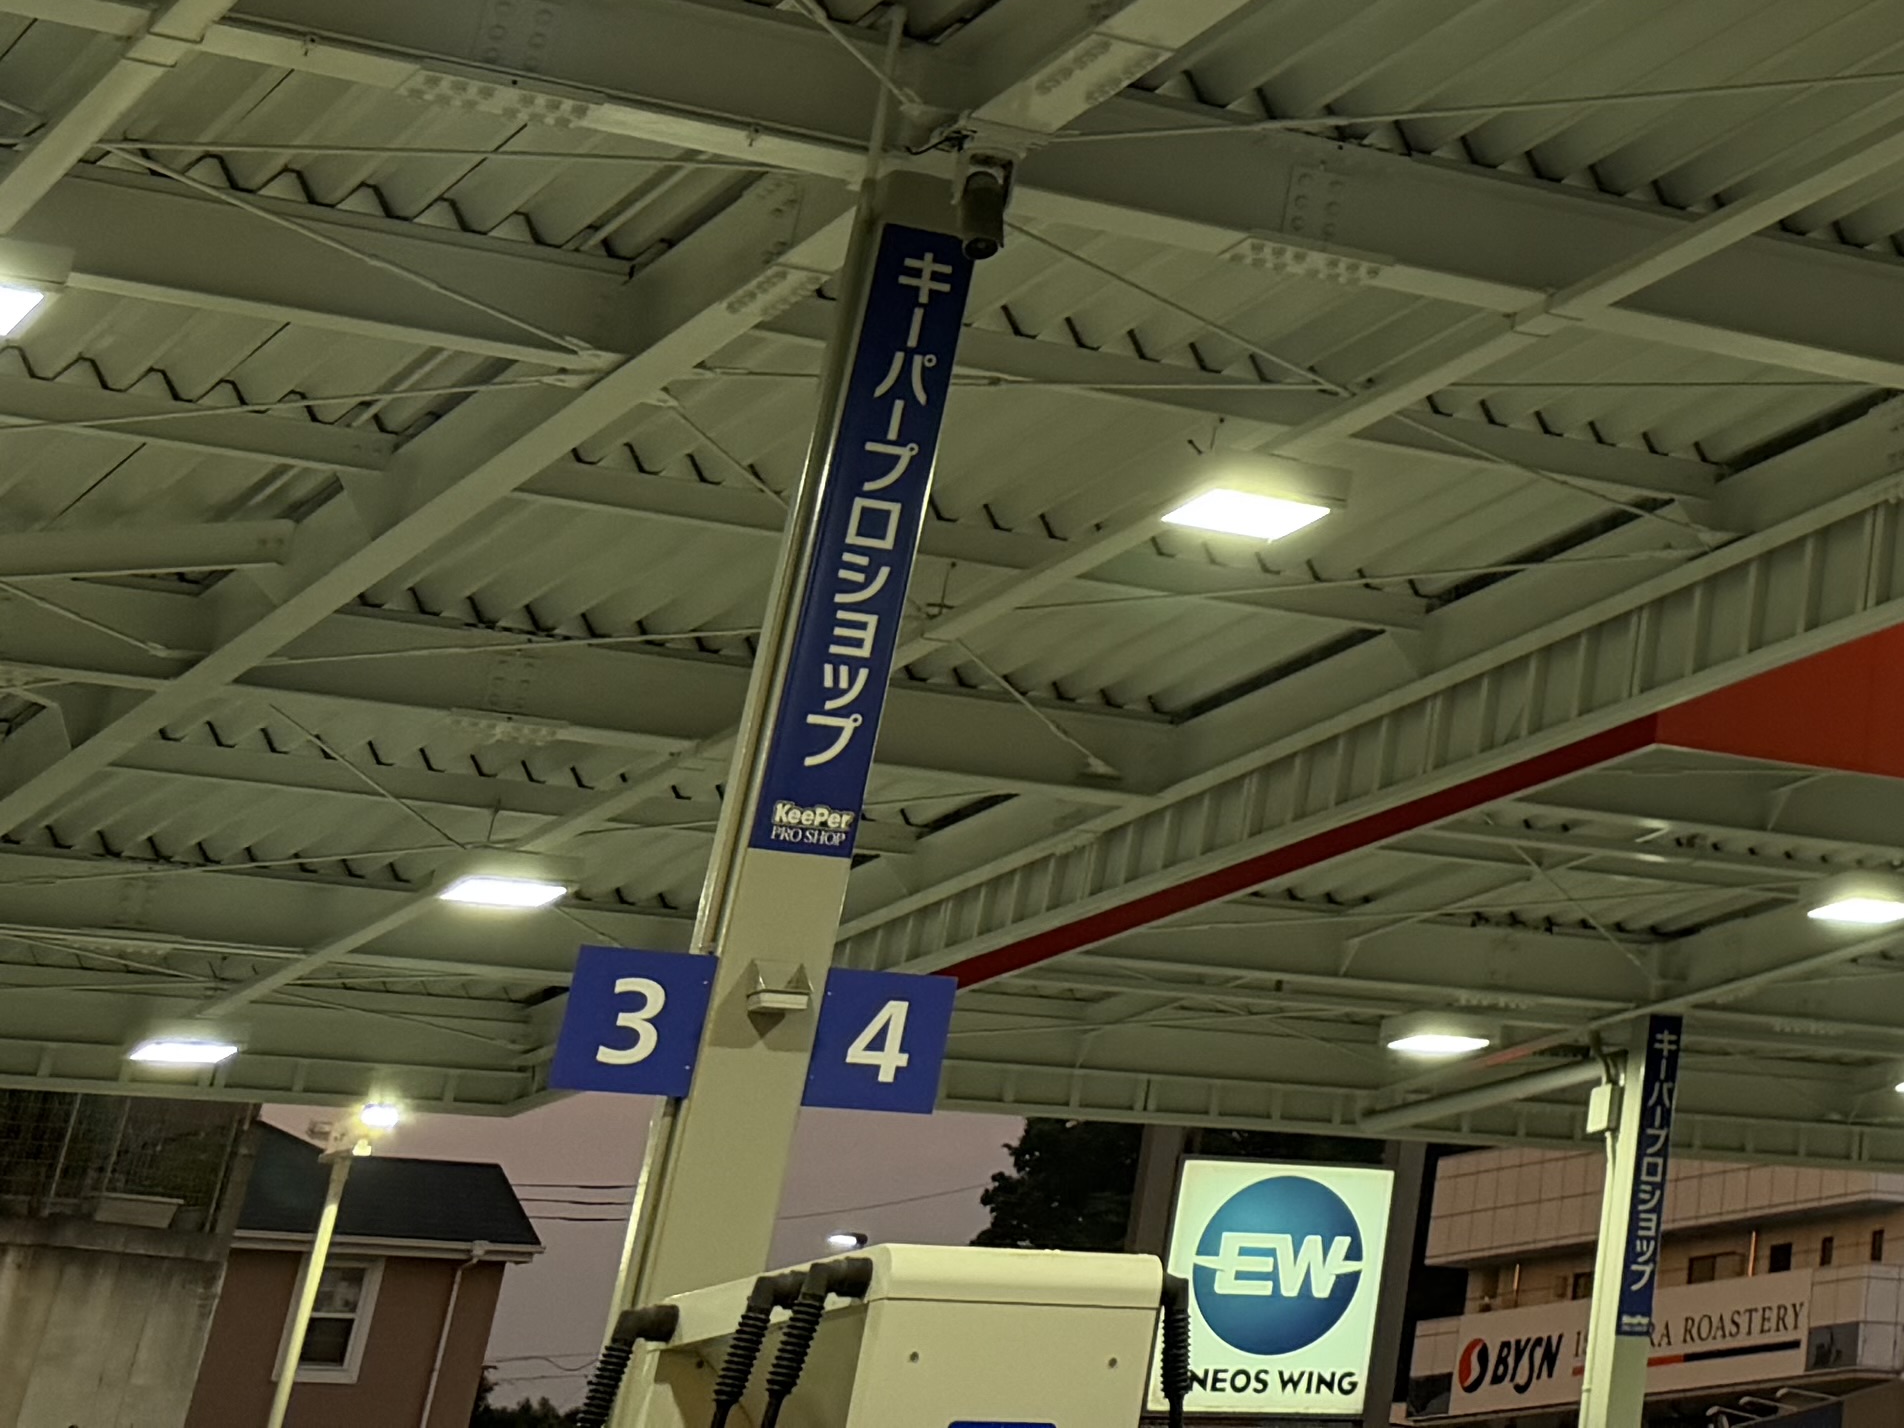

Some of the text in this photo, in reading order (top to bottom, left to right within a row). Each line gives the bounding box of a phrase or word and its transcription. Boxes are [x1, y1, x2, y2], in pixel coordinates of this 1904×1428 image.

[803, 251, 953, 768] キーパープロショップ
[771, 825, 846, 846] PRO SHOP
[773, 801, 853, 830] KeePer
[596, 977, 666, 1066] 3
[845, 1000, 910, 1084] 4
[1214, 1231, 1352, 1298] EW
[1682, 1301, 1805, 1344] ROASTERY
[1188, 1368, 1359, 1395] NEOS WING
